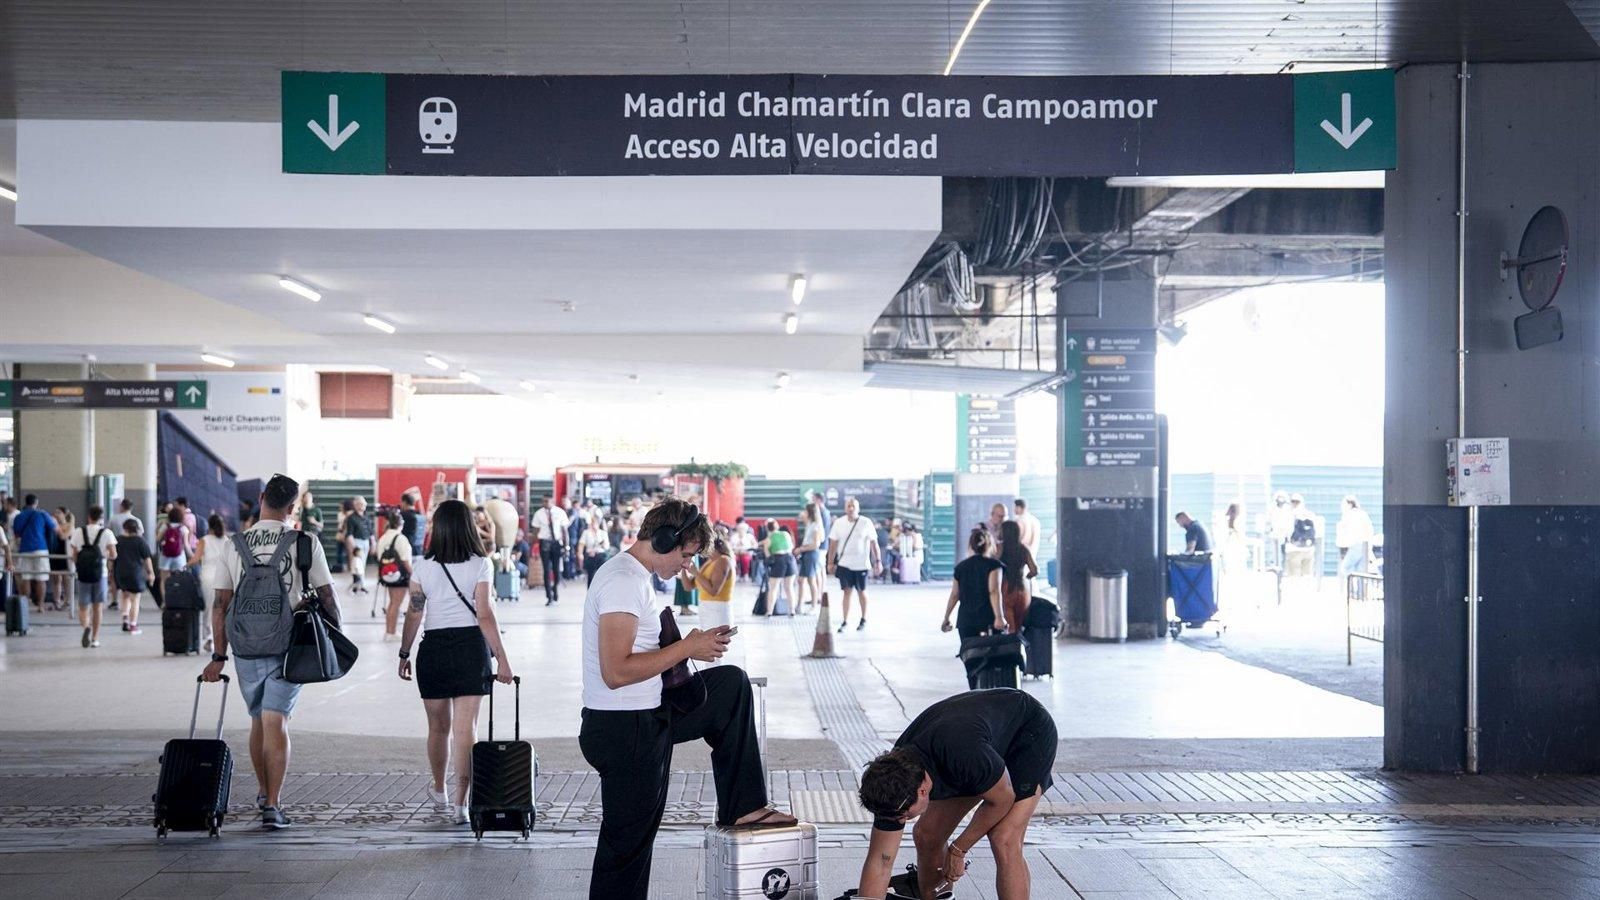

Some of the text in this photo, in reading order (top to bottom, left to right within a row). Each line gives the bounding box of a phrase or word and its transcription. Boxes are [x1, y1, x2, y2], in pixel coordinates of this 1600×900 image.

[624, 90, 1158, 125] Madrid Chamartín Clara Campoamor
[624, 131, 938, 159] Acceso Alta Velocidad
[105, 386, 160, 396] Alta Velocidad
[203, 414, 233, 423] Madrid
[236, 597, 281, 615] VANS
